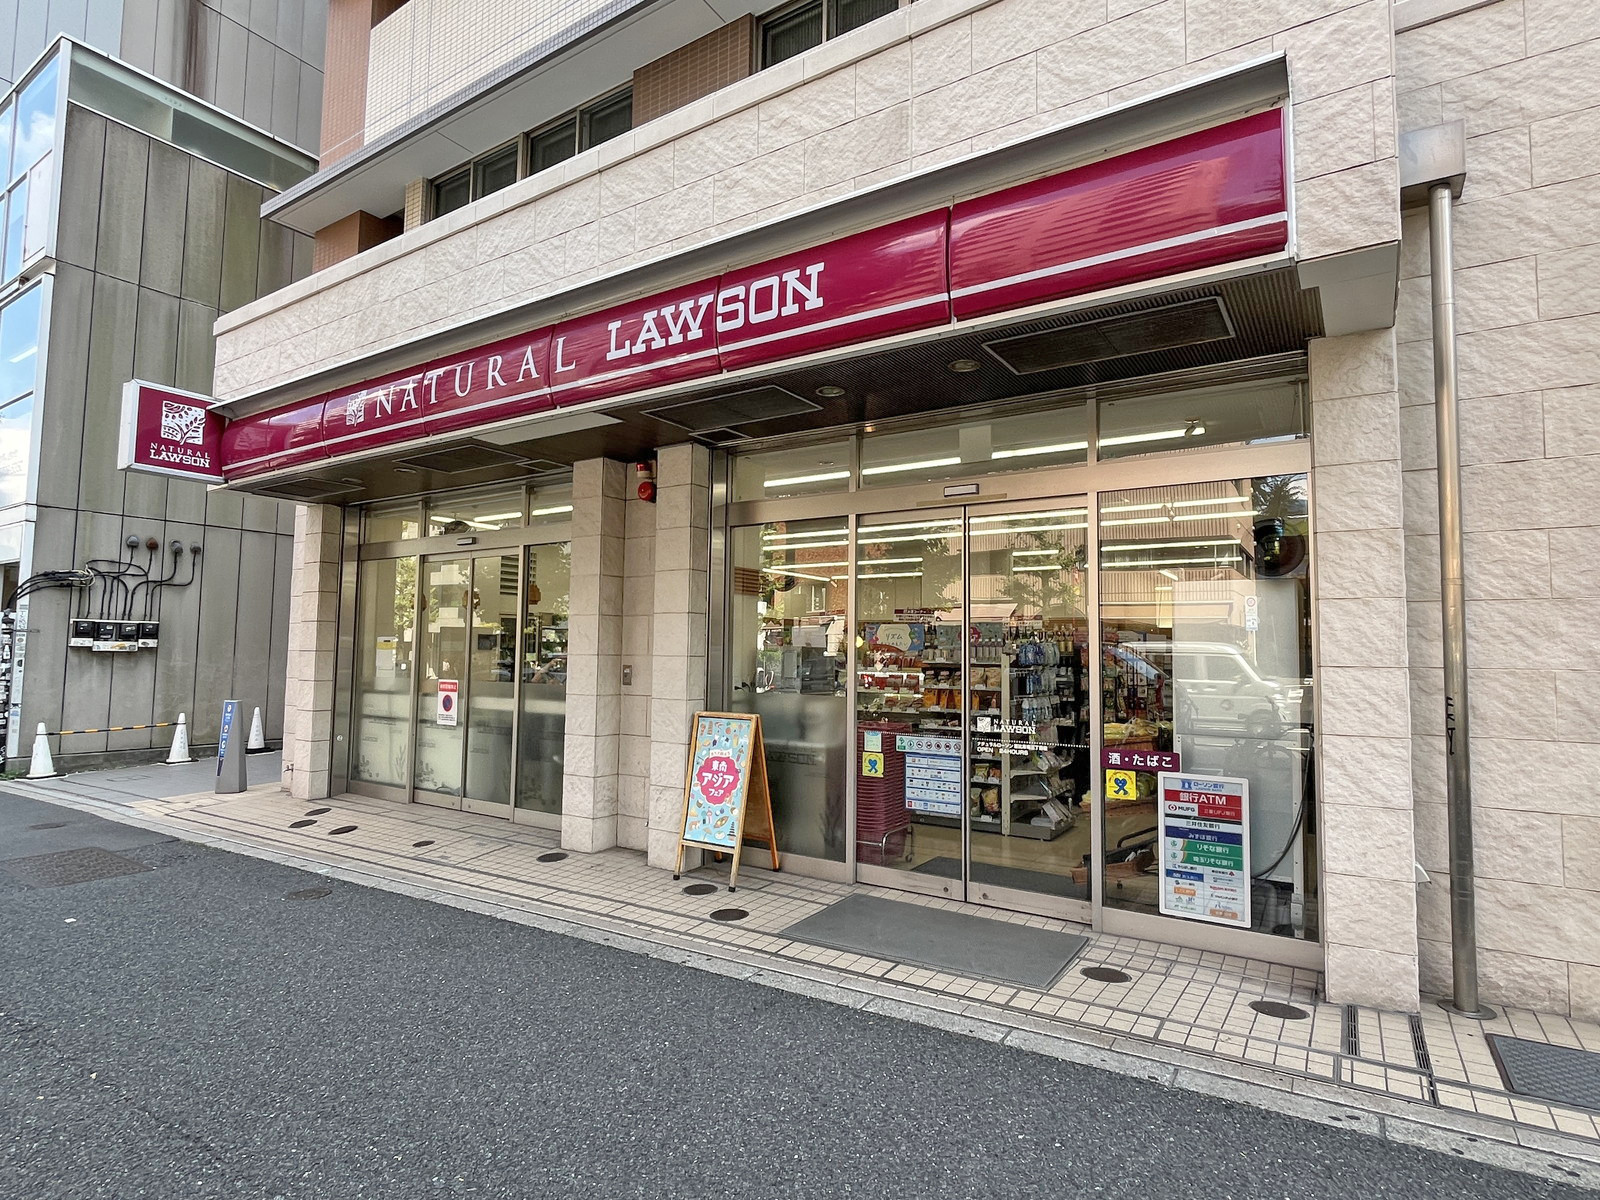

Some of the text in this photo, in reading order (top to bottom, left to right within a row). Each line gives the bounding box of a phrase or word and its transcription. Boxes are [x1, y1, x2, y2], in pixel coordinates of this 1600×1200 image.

[375, 262, 825, 419] NATURAL LAWSON
[150, 442, 211, 459] NATURAL
[149, 449, 211, 468] LAWSON
[993, 718, 1037, 727] NATURAL
[993, 724, 1037, 735] LAWSON
[1108, 752, 1173, 768] 酒・たばこ
[701, 772, 735, 789] アジア
[1193, 781, 1225, 790] ローソン銀行
[708, 788, 725, 797] フェア
[1180, 792, 1227, 805] 銀行ATM
[1186, 820, 1221, 830] 三井住友銀行
[1196, 843, 1230, 854] りそな銀行
